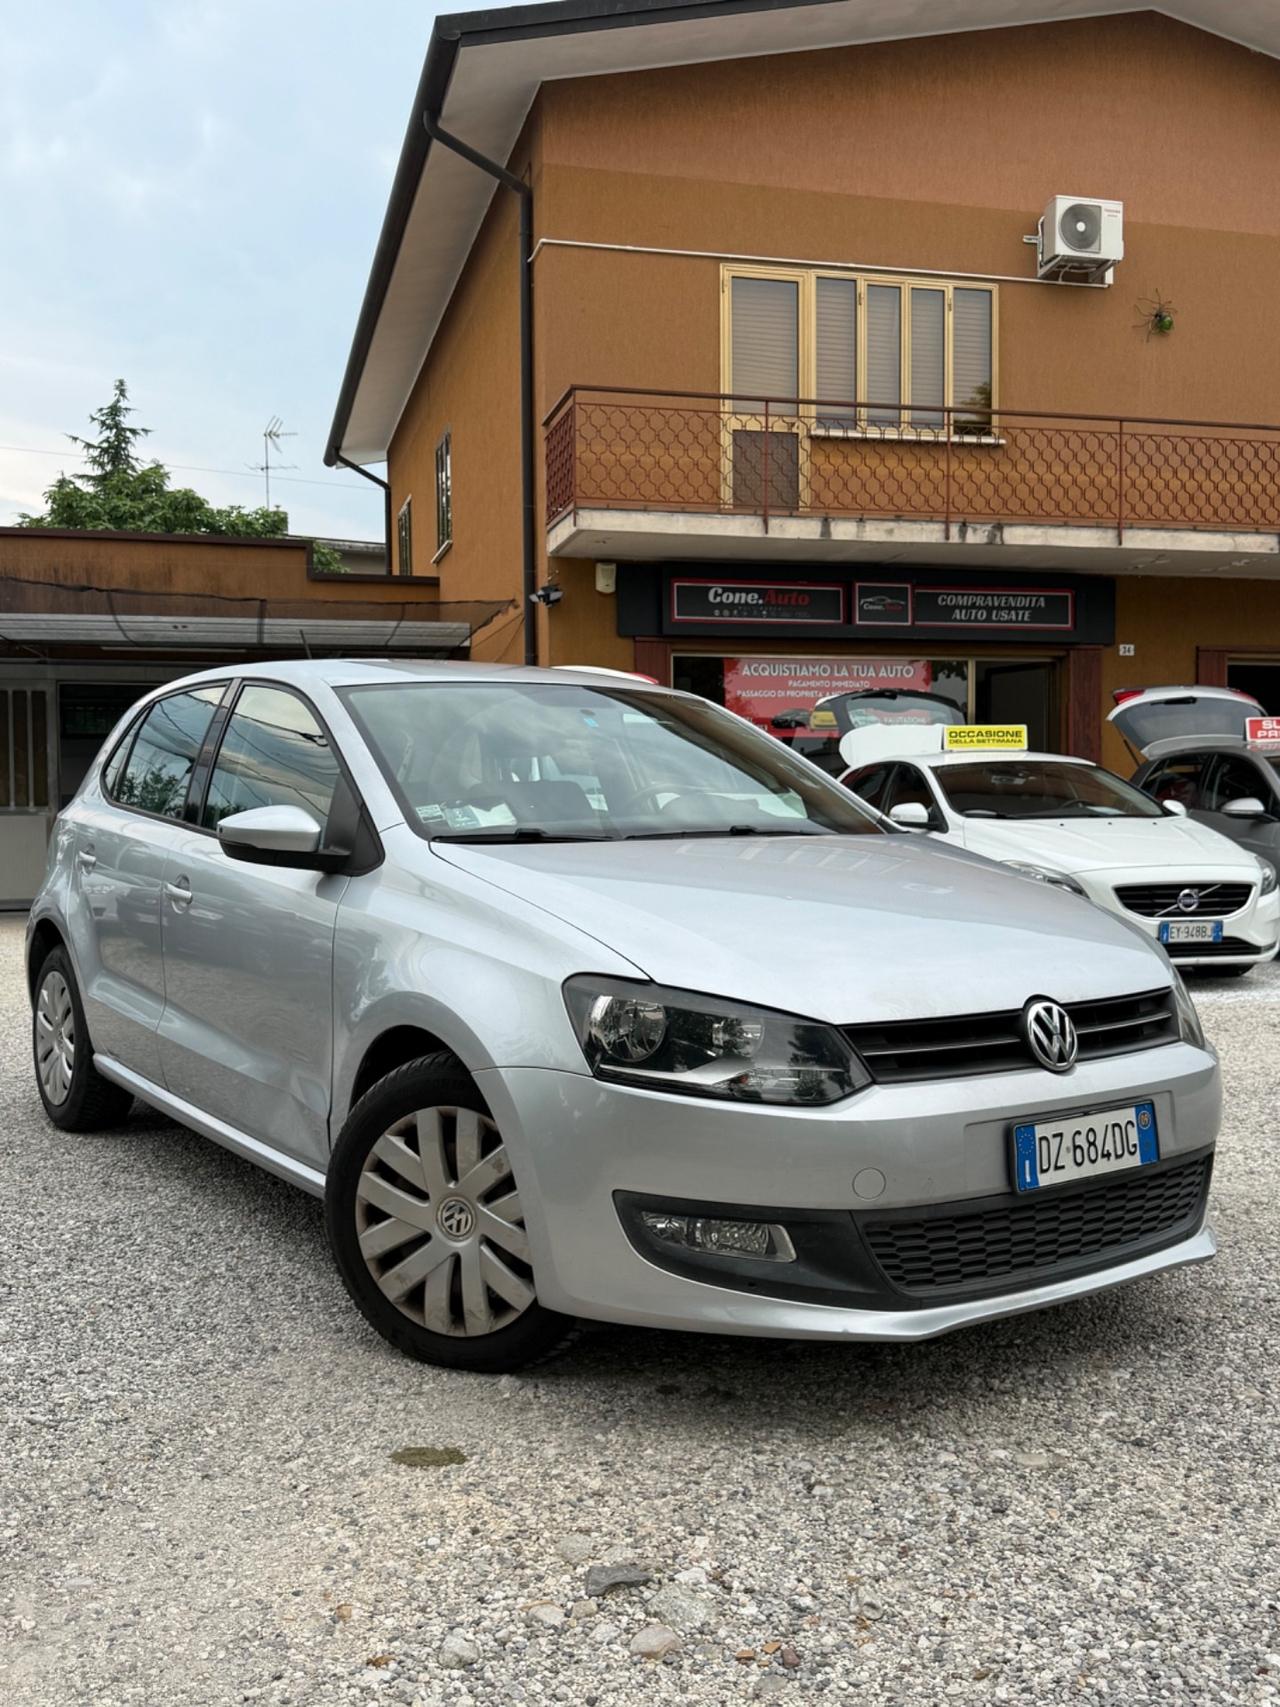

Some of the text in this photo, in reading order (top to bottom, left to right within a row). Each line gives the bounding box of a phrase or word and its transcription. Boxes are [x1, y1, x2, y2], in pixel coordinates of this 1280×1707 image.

[708, 587, 810, 605] Cone.Auto
[938, 594, 1046, 608] COMPRAVENDITA
[952, 609, 1031, 622] AUTO USATE
[742, 663, 914, 678] ACQUISTIAMO LA TUA AUTO
[788, 680, 830, 688] PAGAMENTO
[736, 689, 776, 698] PASSAGGIO
[949, 730, 1023, 739] OCCASIONE
